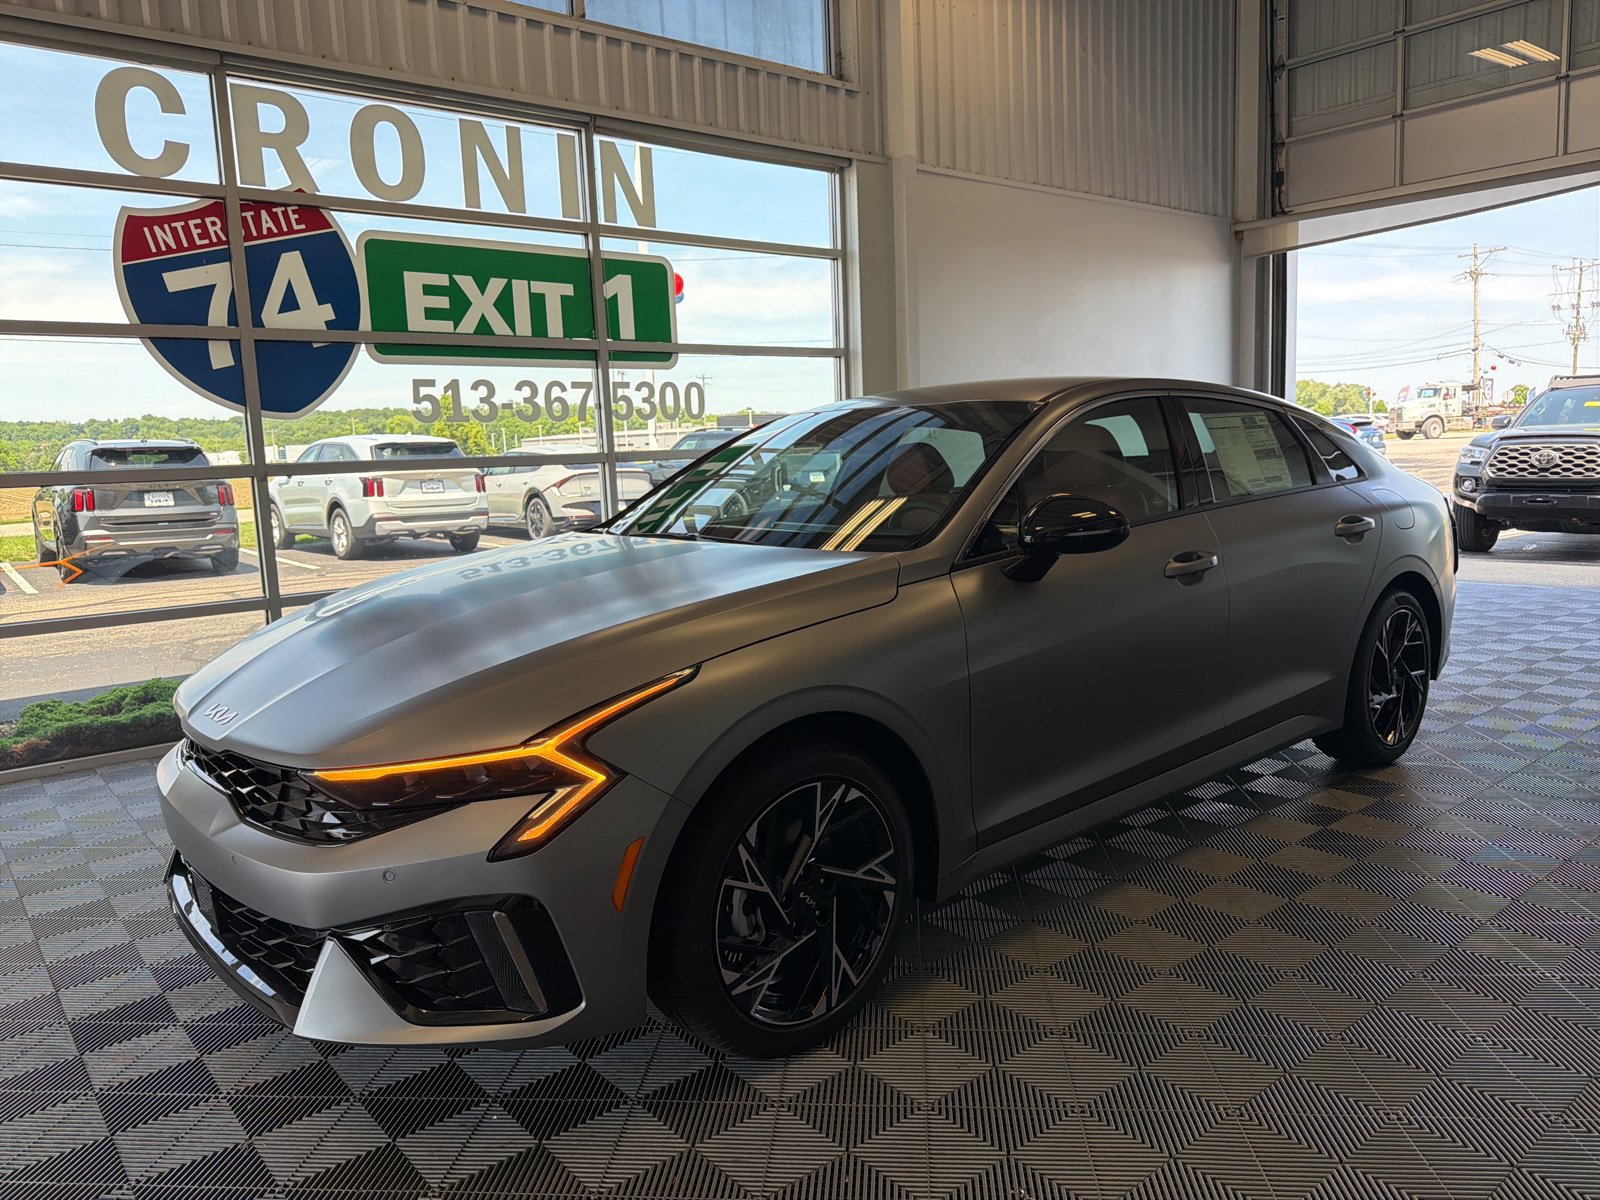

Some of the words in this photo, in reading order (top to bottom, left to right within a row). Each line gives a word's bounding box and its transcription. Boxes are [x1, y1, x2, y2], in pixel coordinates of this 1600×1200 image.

[94, 66, 657, 229] CRONIN
[143, 206, 306, 253] INTERTATE
[162, 250, 336, 370] 74
[403, 271, 574, 339] EXIT
[603, 274, 635, 340] 1
[411, 378, 706, 424] 513-3675300
